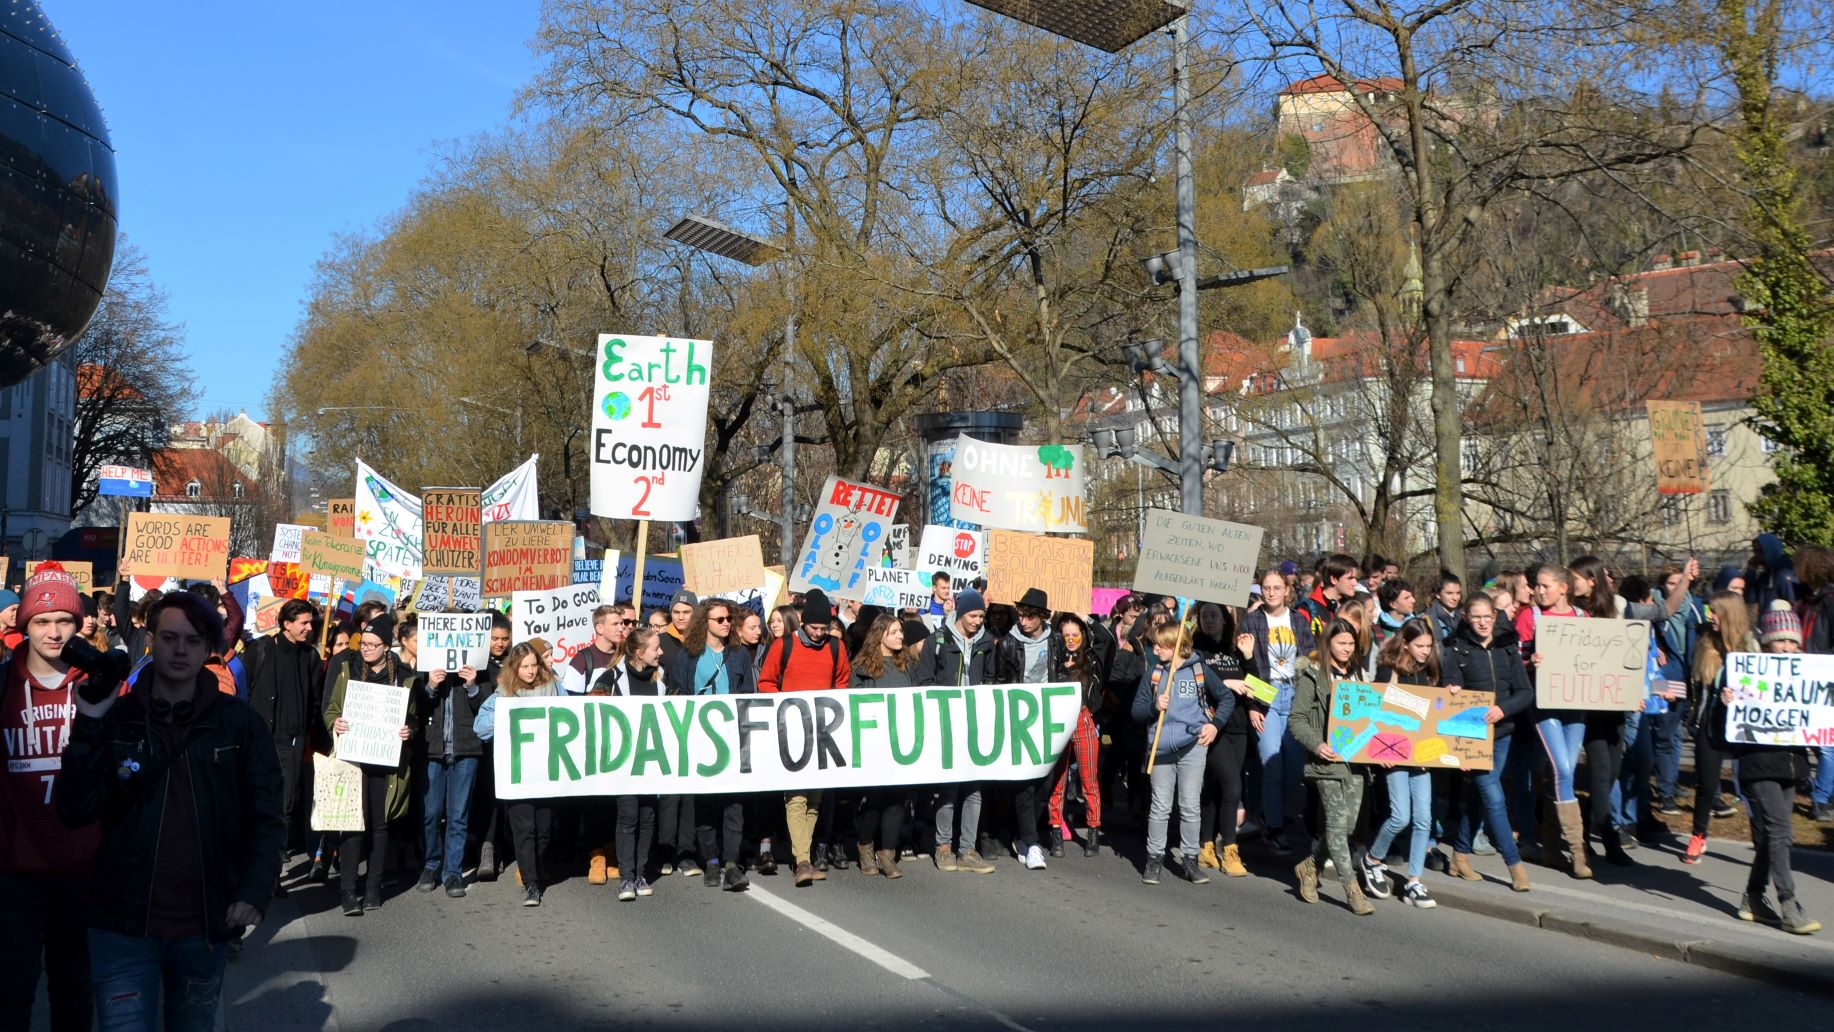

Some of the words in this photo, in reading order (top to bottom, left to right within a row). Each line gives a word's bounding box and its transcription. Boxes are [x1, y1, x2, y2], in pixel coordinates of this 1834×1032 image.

[602, 339, 706, 385] Earth
[637, 384, 671, 429] 1st
[595, 428, 701, 472] Economy
[963, 445, 1033, 478] OHNE
[101, 467, 127, 479] HELP
[131, 469, 149, 480] ME
[424, 493, 480, 507] GRATIS
[631, 471, 665, 516] 2nd
[829, 479, 903, 518] RETTET
[953, 480, 992, 513] KEINE
[424, 506, 480, 522] HEROIN
[136, 521, 181, 536] WORDS
[186, 524, 212, 538] ARE
[452, 523, 480, 536] ALLE
[495, 523, 518, 537] DER
[523, 521, 566, 535] UMWELT
[1157, 517, 1171, 528] DIE
[1181, 521, 1216, 534] GUTEN
[1222, 528, 1252, 541] ALTEN
[135, 535, 173, 549] GOOD
[180, 537, 228, 554] ACTIONS
[428, 534, 481, 551] UMWELT
[505, 538, 518, 547] ZU
[522, 536, 551, 546] LIEBE
[801, 512, 834, 578] OLAF
[954, 538, 974, 553] STOP
[995, 534, 1022, 554] BE
[1029, 537, 1078, 559] PART
[1208, 542, 1224, 553] WO
[129, 549, 152, 564] ARE
[282, 550, 298, 559] NOT
[487, 547, 570, 568] KONDOMVERBOT
[683, 541, 754, 563] FATHERS
[847, 521, 882, 589] OLAF
[1146, 549, 1201, 567] ERWACHSENE
[1210, 560, 1228, 571] UNS
[575, 560, 599, 571] BELIEVE
[713, 562, 723, 577] 4
[994, 553, 1091, 583] SOLUTION
[692, 573, 754, 593] FUTURE
[868, 568, 909, 584] PLANET
[524, 599, 545, 614] To
[552, 596, 568, 611] Do
[899, 593, 931, 608] FIRST
[420, 617, 457, 631] THERE
[461, 618, 473, 631] IS
[475, 616, 491, 630] NO
[524, 620, 550, 635] You
[557, 616, 588, 631] Have
[427, 633, 485, 648] PLANET
[1545, 622, 1624, 658] #Fridays
[1572, 654, 1597, 672] for
[1735, 655, 1801, 676] HEUTE
[1179, 681, 1196, 694] 85
[1550, 673, 1632, 704] FUTURE
[1343, 702, 1351, 716] B
[1732, 705, 1810, 727] MORGEN
